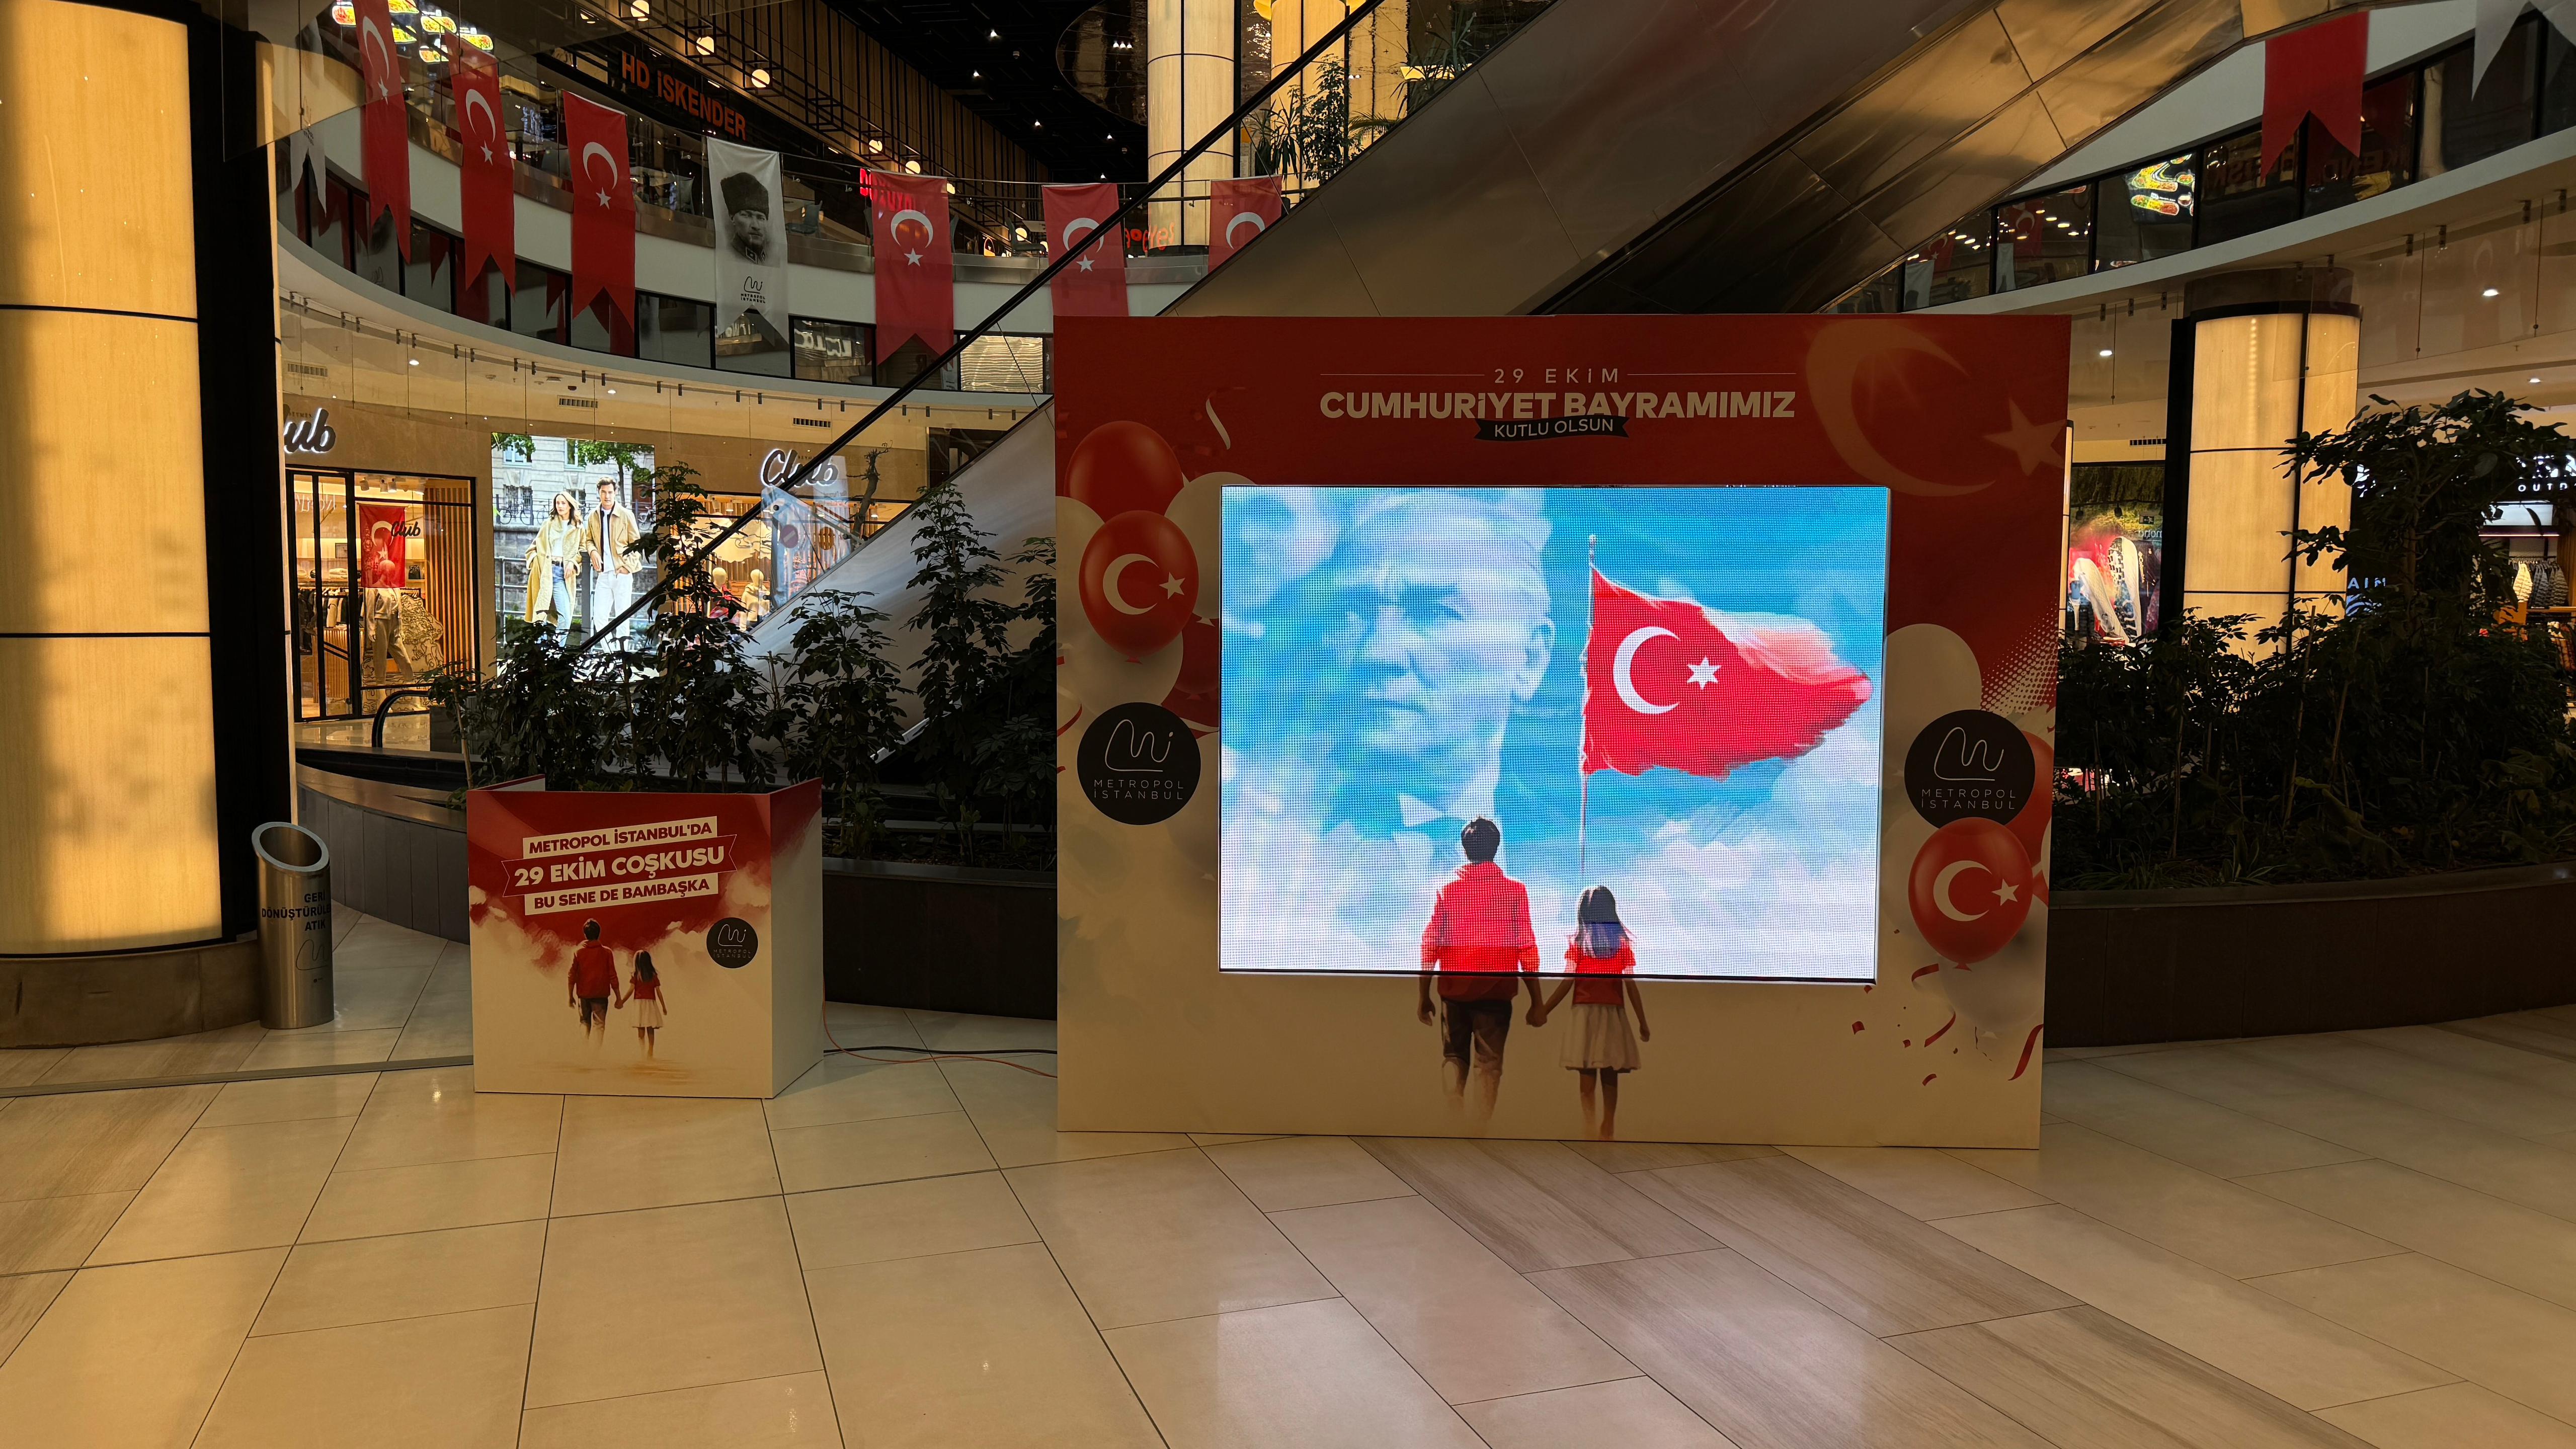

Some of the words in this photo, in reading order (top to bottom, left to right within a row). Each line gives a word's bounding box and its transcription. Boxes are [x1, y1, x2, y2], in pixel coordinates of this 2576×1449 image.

[622, 51, 650, 89] HD
[658, 70, 747, 141] İSKENDER
[1494, 368, 1524, 383] 29
[1545, 368, 1619, 383] EKİM
[1320, 391, 1557, 419] CUMHURİYET
[1564, 391, 1796, 419] BAYRAMIMIZ
[283, 404, 336, 453] ub
[1494, 422, 1549, 438] KUTLU
[1554, 418, 1614, 434] OLSUN
[2518, 482, 2576, 492] OUTD
[391, 521, 421, 537] Club
[1094, 779, 1184, 789] METROPOL
[1094, 788, 1183, 799] İSTANBUL
[1921, 789, 2016, 798] METROPOL
[1921, 798, 2015, 810] İSTANBUL
[529, 834, 610, 854] METROPOL
[614, 822, 712, 844] İSTANBUL'DA
[514, 866, 544, 887] 29
[550, 856, 606, 882] EKİM
[611, 846, 725, 878] COŞKUSU
[304, 891, 326, 903] GERİ
[534, 896, 555, 909] BU
[559, 891, 596, 906] SENE
[600, 889, 619, 902] DE
[623, 878, 710, 900] BAMBAŞKA
[305, 919, 326, 931] ATIK
